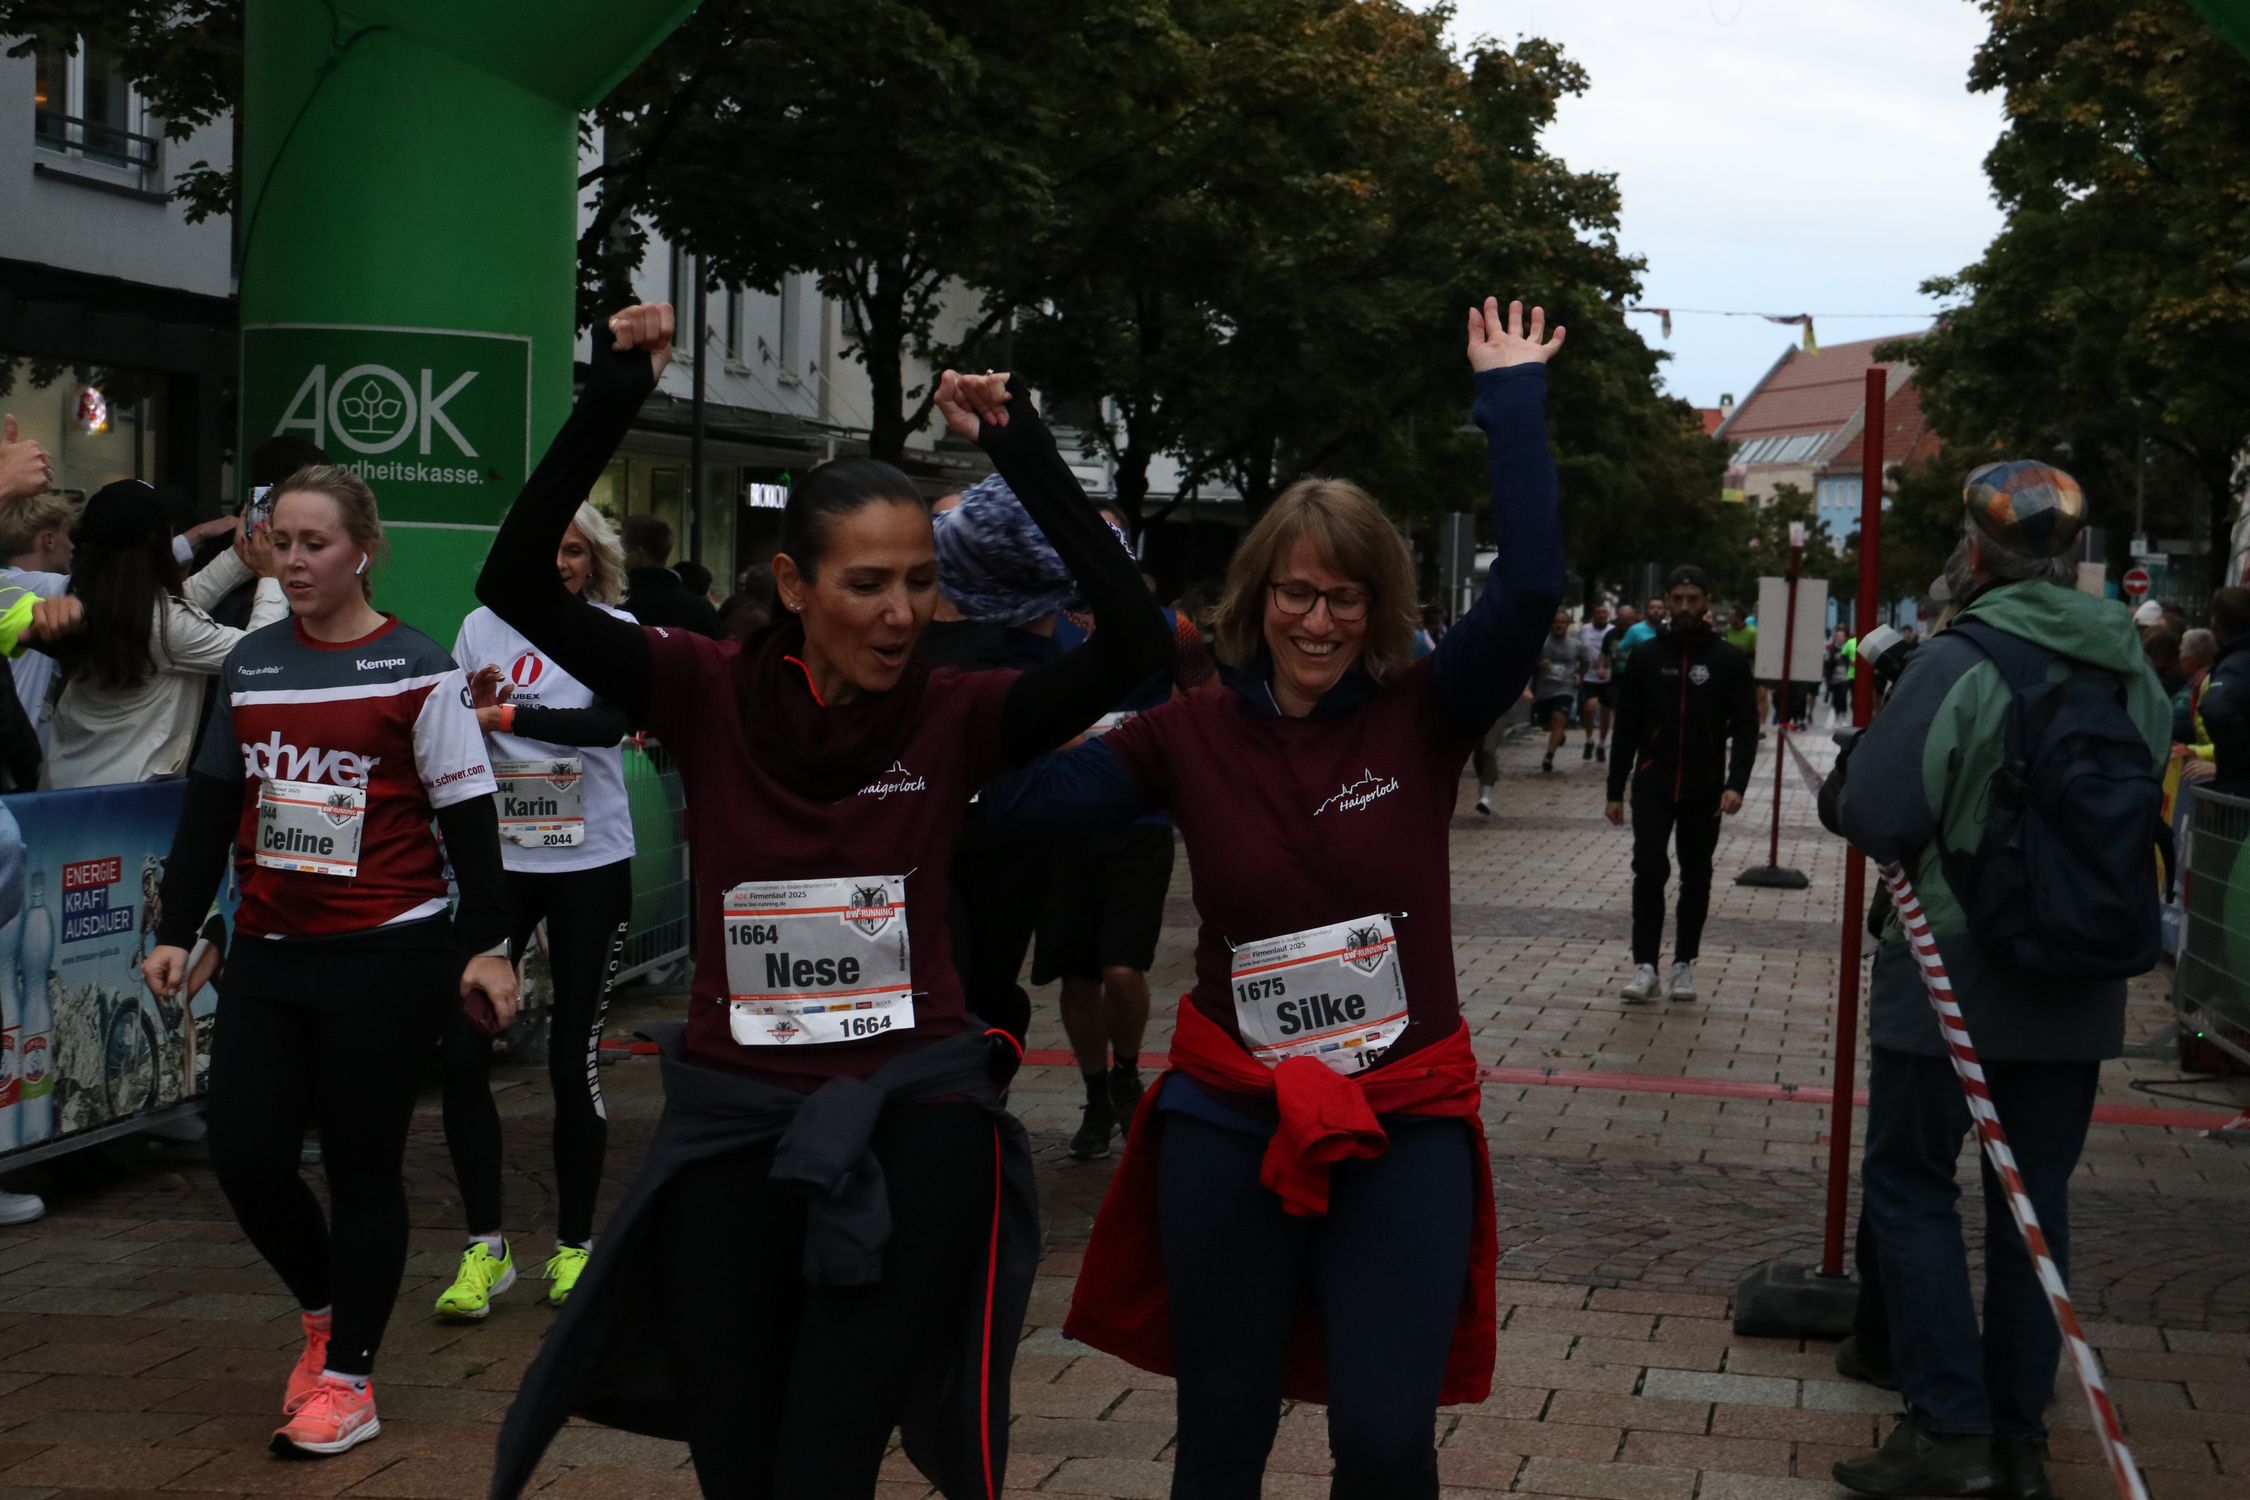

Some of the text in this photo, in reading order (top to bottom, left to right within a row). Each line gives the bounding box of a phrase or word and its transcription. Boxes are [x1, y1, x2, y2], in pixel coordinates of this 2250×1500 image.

[272, 364, 480, 458] AOK
[333, 460, 484, 485] ndheitskasse.
[355, 656, 407, 671] Kempa
[504, 796, 558, 817] Karin
[1340, 777, 1400, 812] Haigerloch
[263, 824, 334, 855] Celine
[543, 833, 572, 845] 2044
[65, 861, 117, 887] ENERGIE
[64, 888, 107, 914] KRAFT
[749, 891, 787, 900] Firmenlauf
[788, 891, 807, 899] 2025
[64, 909, 130, 940] AUSDAUER
[728, 925, 779, 946] 1664
[1252, 945, 1288, 958] Firmenlauf
[1289, 941, 1307, 951] 2025
[765, 952, 860, 989] Nese
[1237, 977, 1286, 1003] 1675
[839, 1014, 892, 1038] 1664
[1276, 993, 1367, 1035] Silke
